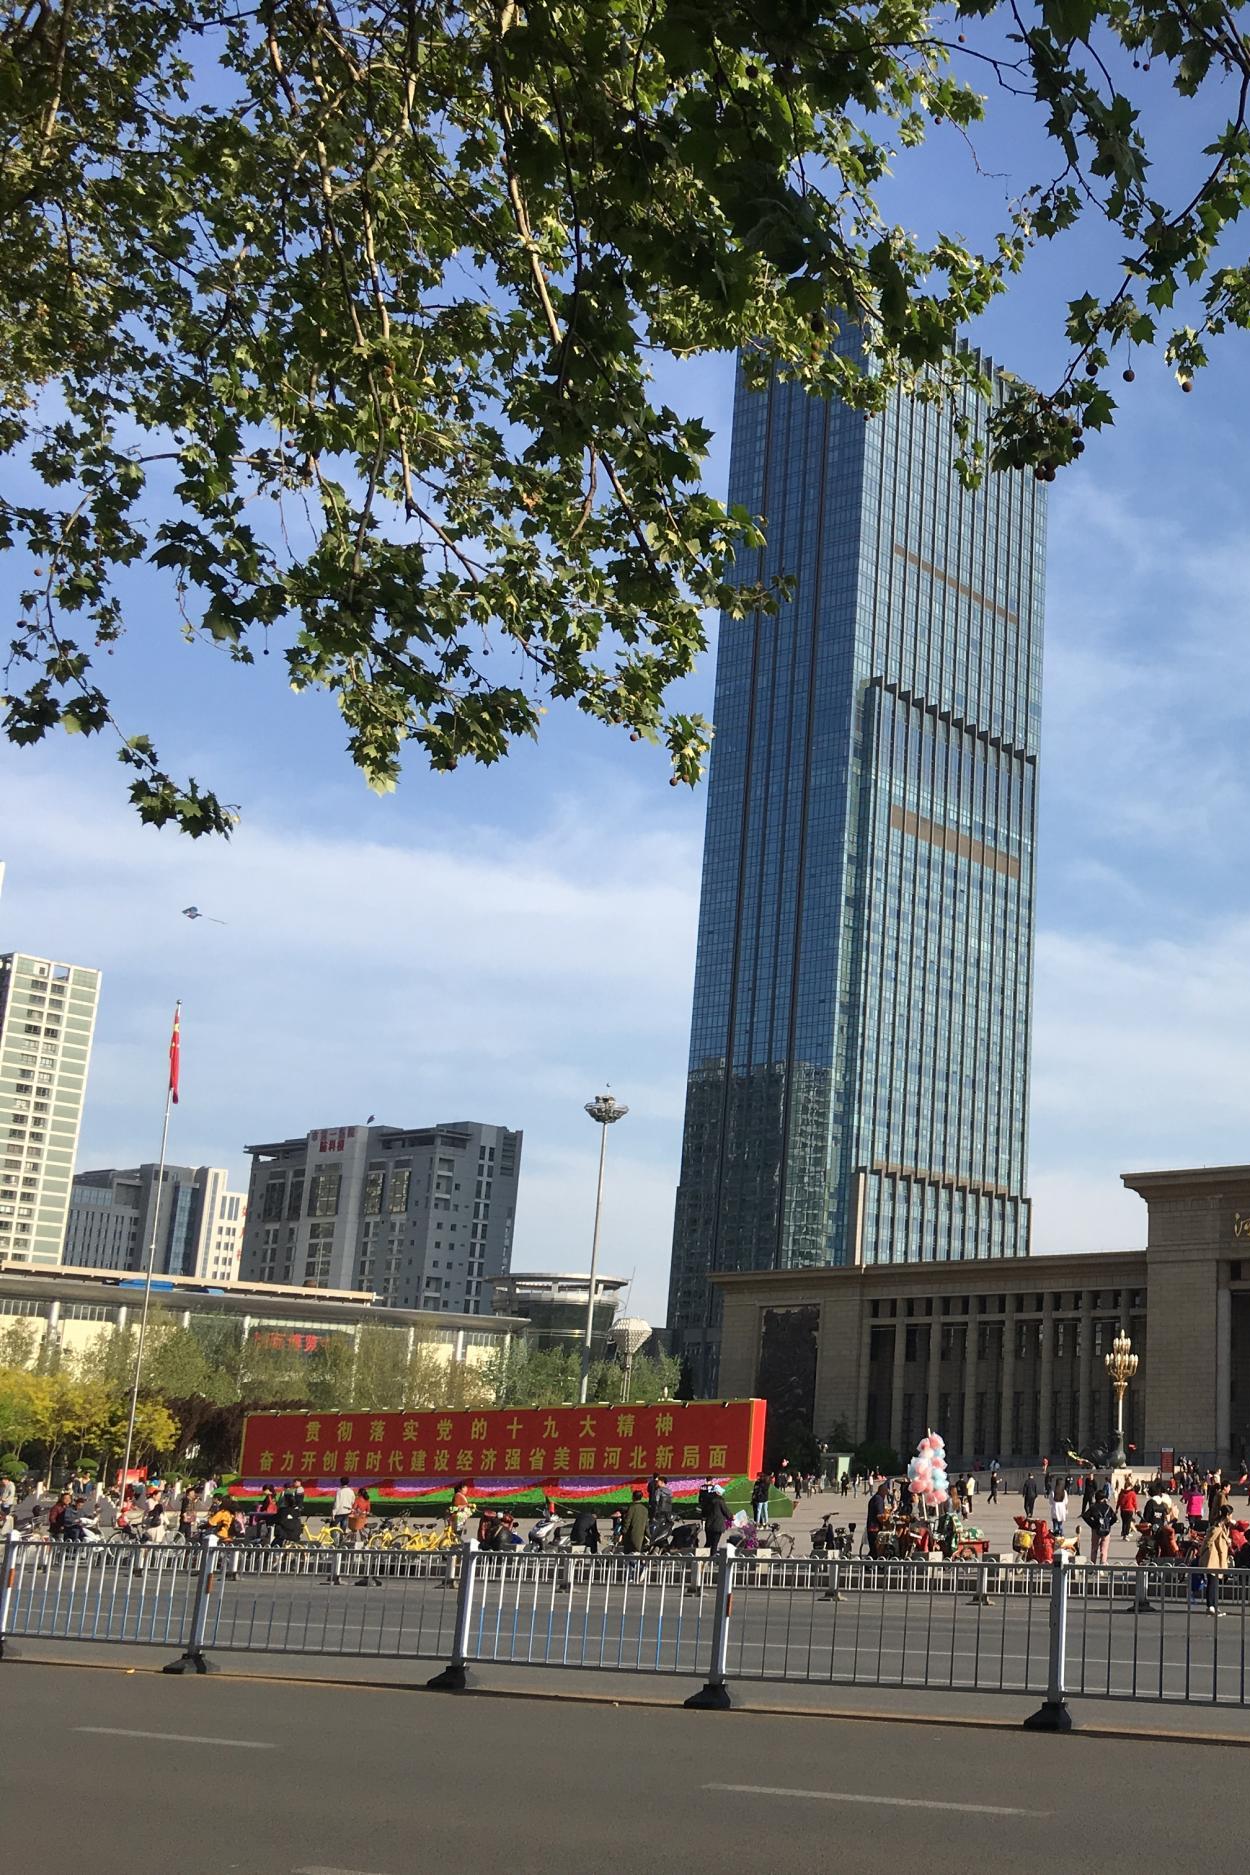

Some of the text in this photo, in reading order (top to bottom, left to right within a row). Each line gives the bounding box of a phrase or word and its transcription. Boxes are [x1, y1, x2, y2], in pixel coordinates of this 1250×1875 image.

[305, 1412, 673, 1442] 贯彻落实党的十九大精神
[259, 1445, 728, 1472] 奋力开创新时代建设经济强省美丽河北新局面
